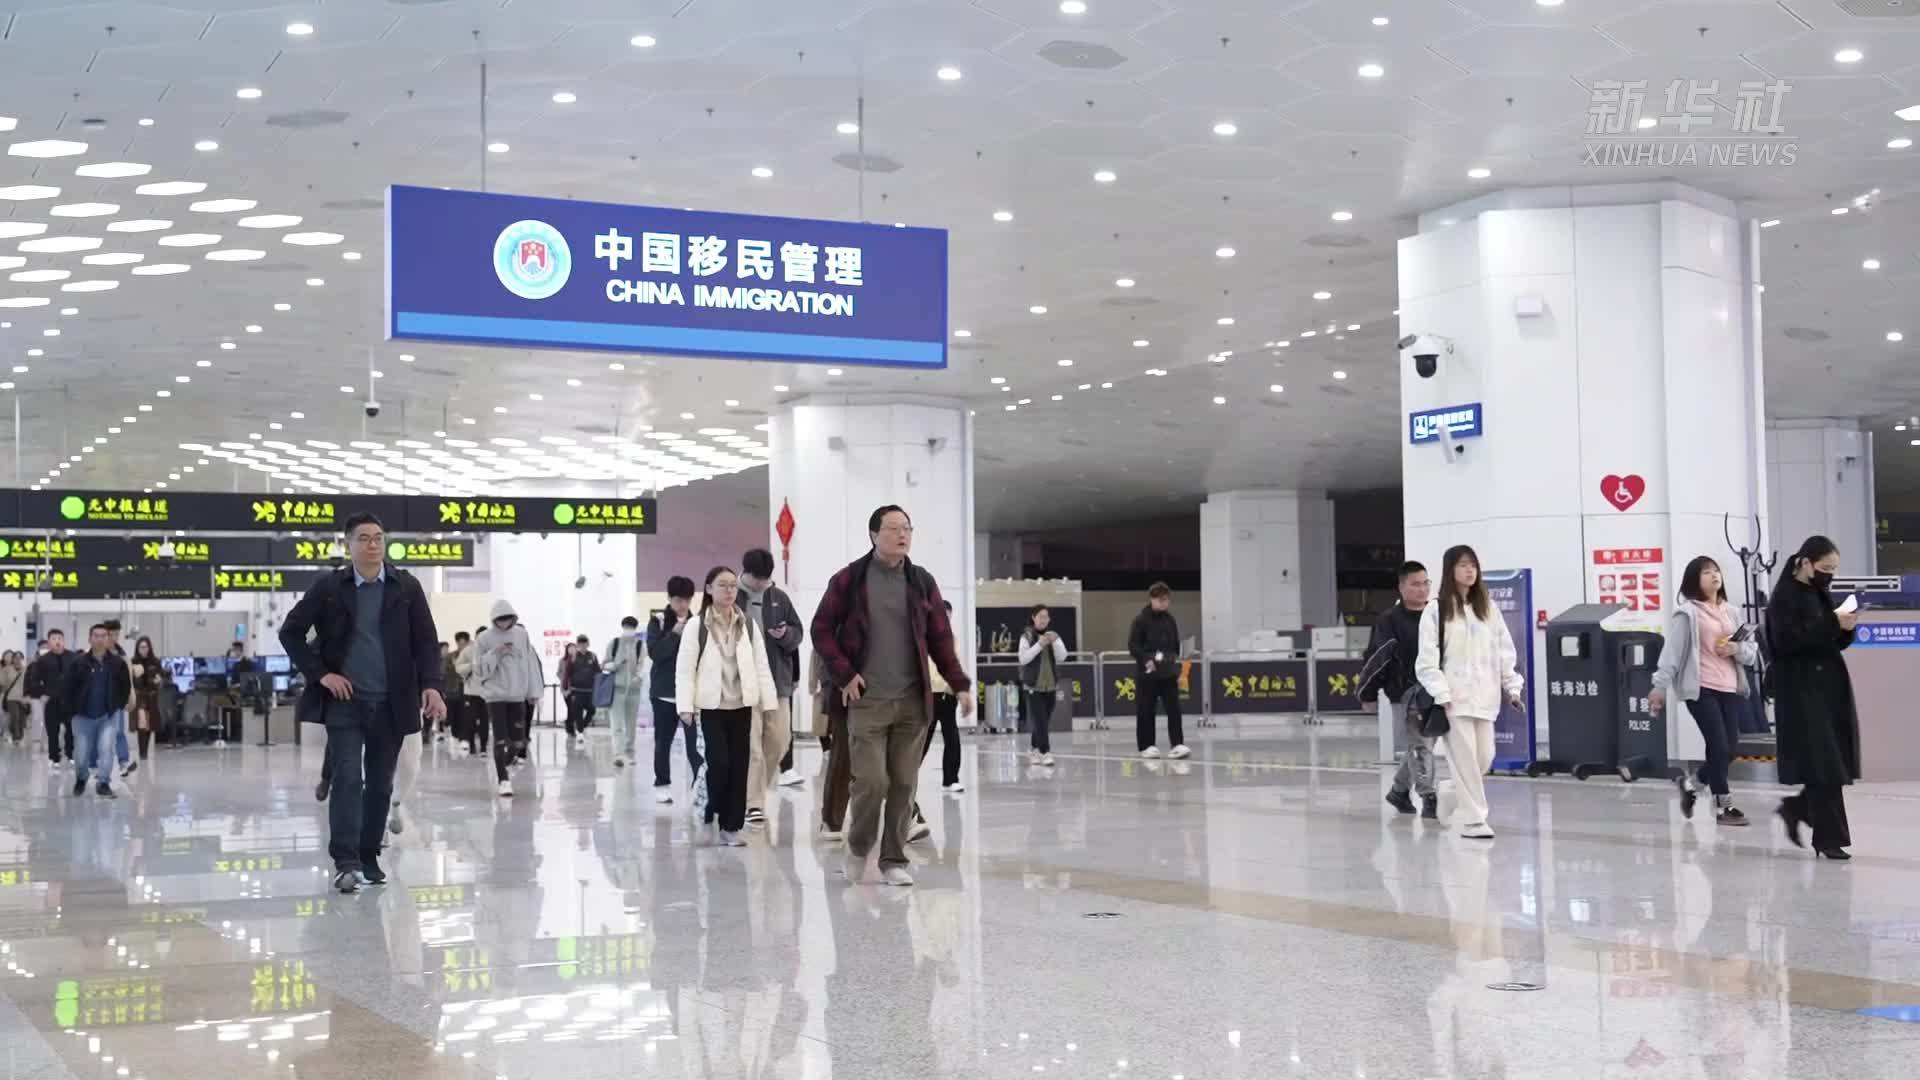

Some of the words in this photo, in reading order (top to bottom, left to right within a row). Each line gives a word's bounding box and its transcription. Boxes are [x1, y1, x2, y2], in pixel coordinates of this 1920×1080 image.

[595, 228, 863, 286] 中国移民管理
[606, 279, 685, 305] CHINA
[694, 285, 854, 317] IMMIGRATION
[1551, 681, 1599, 696] 珠海边检
[1629, 720, 1651, 731] POLICE
